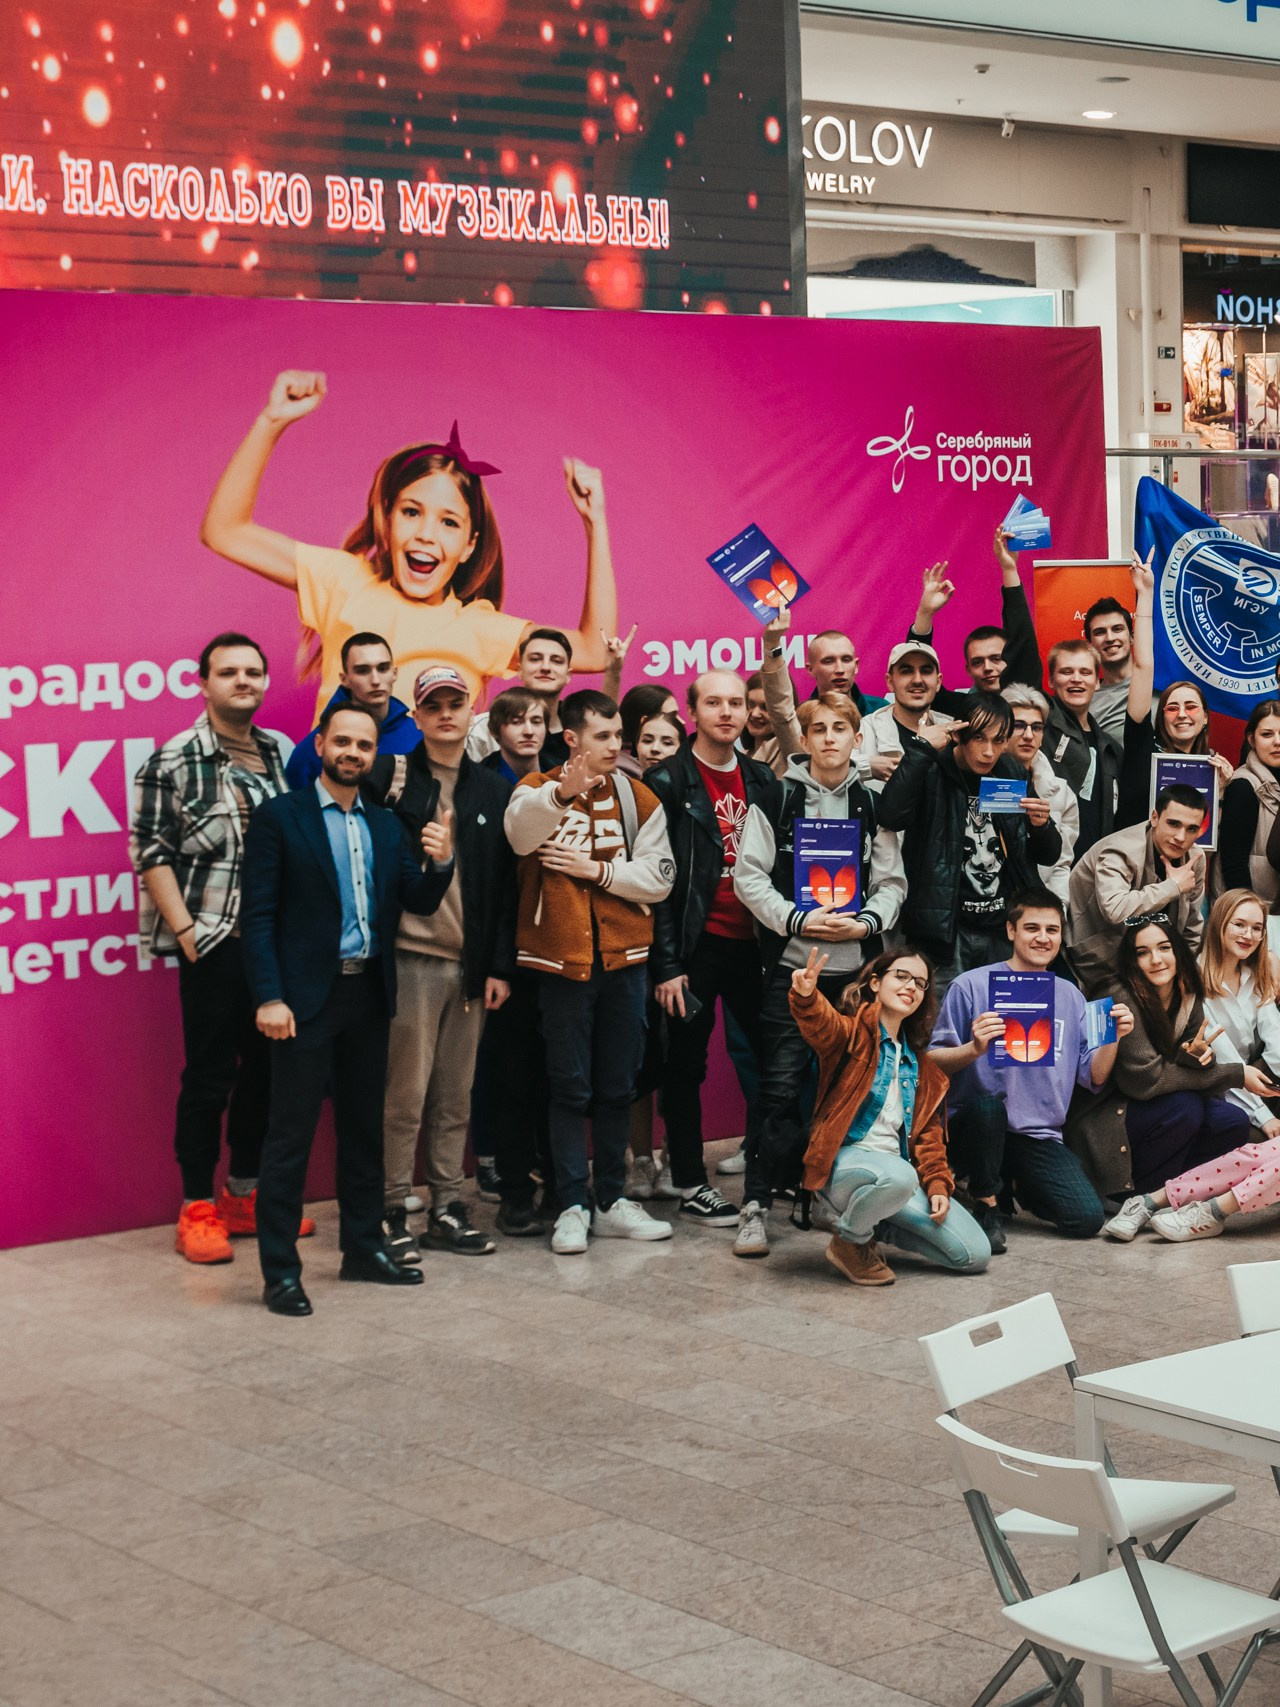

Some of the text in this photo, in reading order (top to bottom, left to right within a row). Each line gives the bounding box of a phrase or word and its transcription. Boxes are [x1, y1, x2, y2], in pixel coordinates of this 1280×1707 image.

[806, 171, 876, 195] WELRY
[62, 159, 313, 229] НАСКОЛЬКО
[327, 175, 387, 233] ВЫ
[399, 180, 671, 250] МУЗЫКАЛЬНЫ!
[936, 432, 1032, 451] Серебряный
[1233, 595, 1270, 615] ИГЭУ
[1193, 594, 1222, 648] SEMPER
[642, 637, 816, 677] ЭМОЦИ
[1250, 648, 1264, 659] IN
[1218, 676, 1240, 690] 1930
